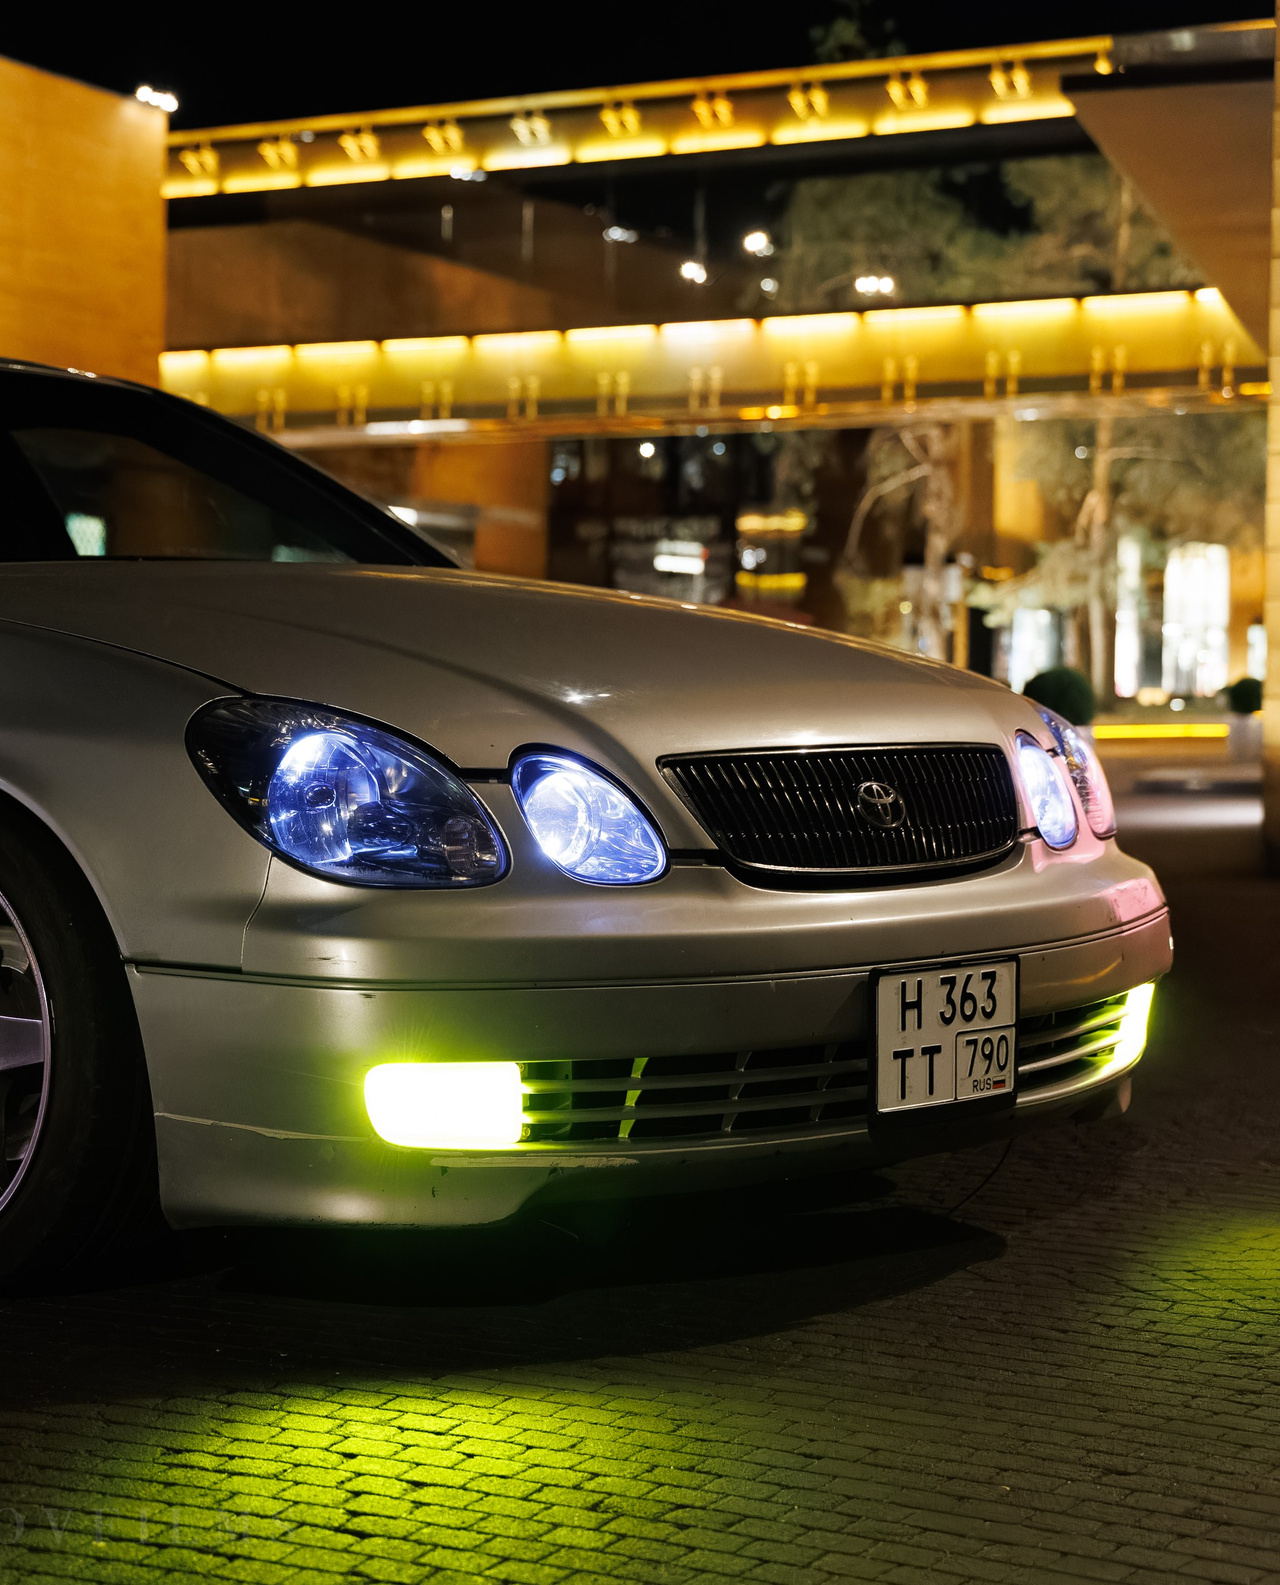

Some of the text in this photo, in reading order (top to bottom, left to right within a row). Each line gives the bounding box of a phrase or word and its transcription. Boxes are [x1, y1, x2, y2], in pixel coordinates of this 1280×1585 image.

[900, 969, 997, 1032] H 363
[892, 1034, 1009, 1100] TT 790
[972, 1078, 992, 1093] RUS
